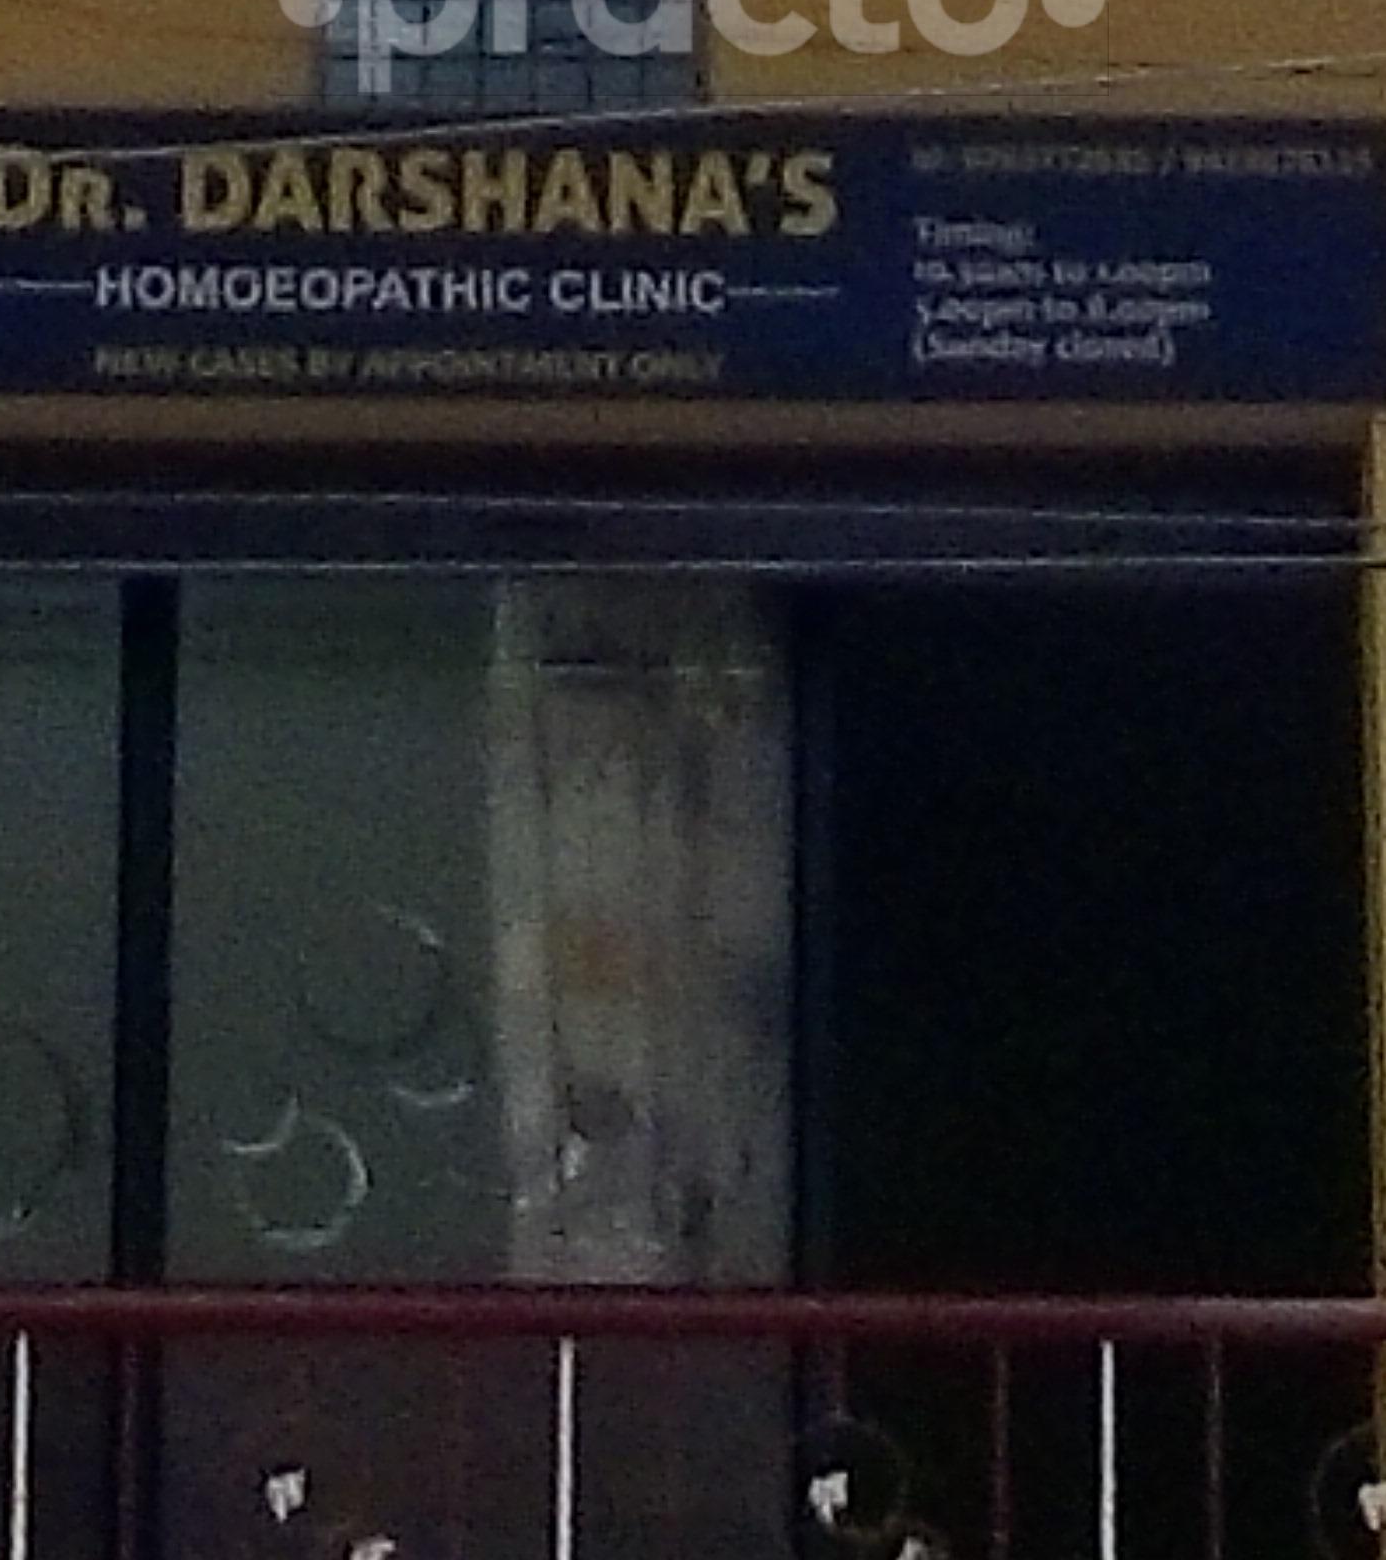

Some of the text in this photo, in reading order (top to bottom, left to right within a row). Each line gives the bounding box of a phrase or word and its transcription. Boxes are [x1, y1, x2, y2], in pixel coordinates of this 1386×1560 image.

[181, 146, 839, 236] DARSHANA'S
[94, 266, 727, 316] HOMOEOPATHIC CLINIC
